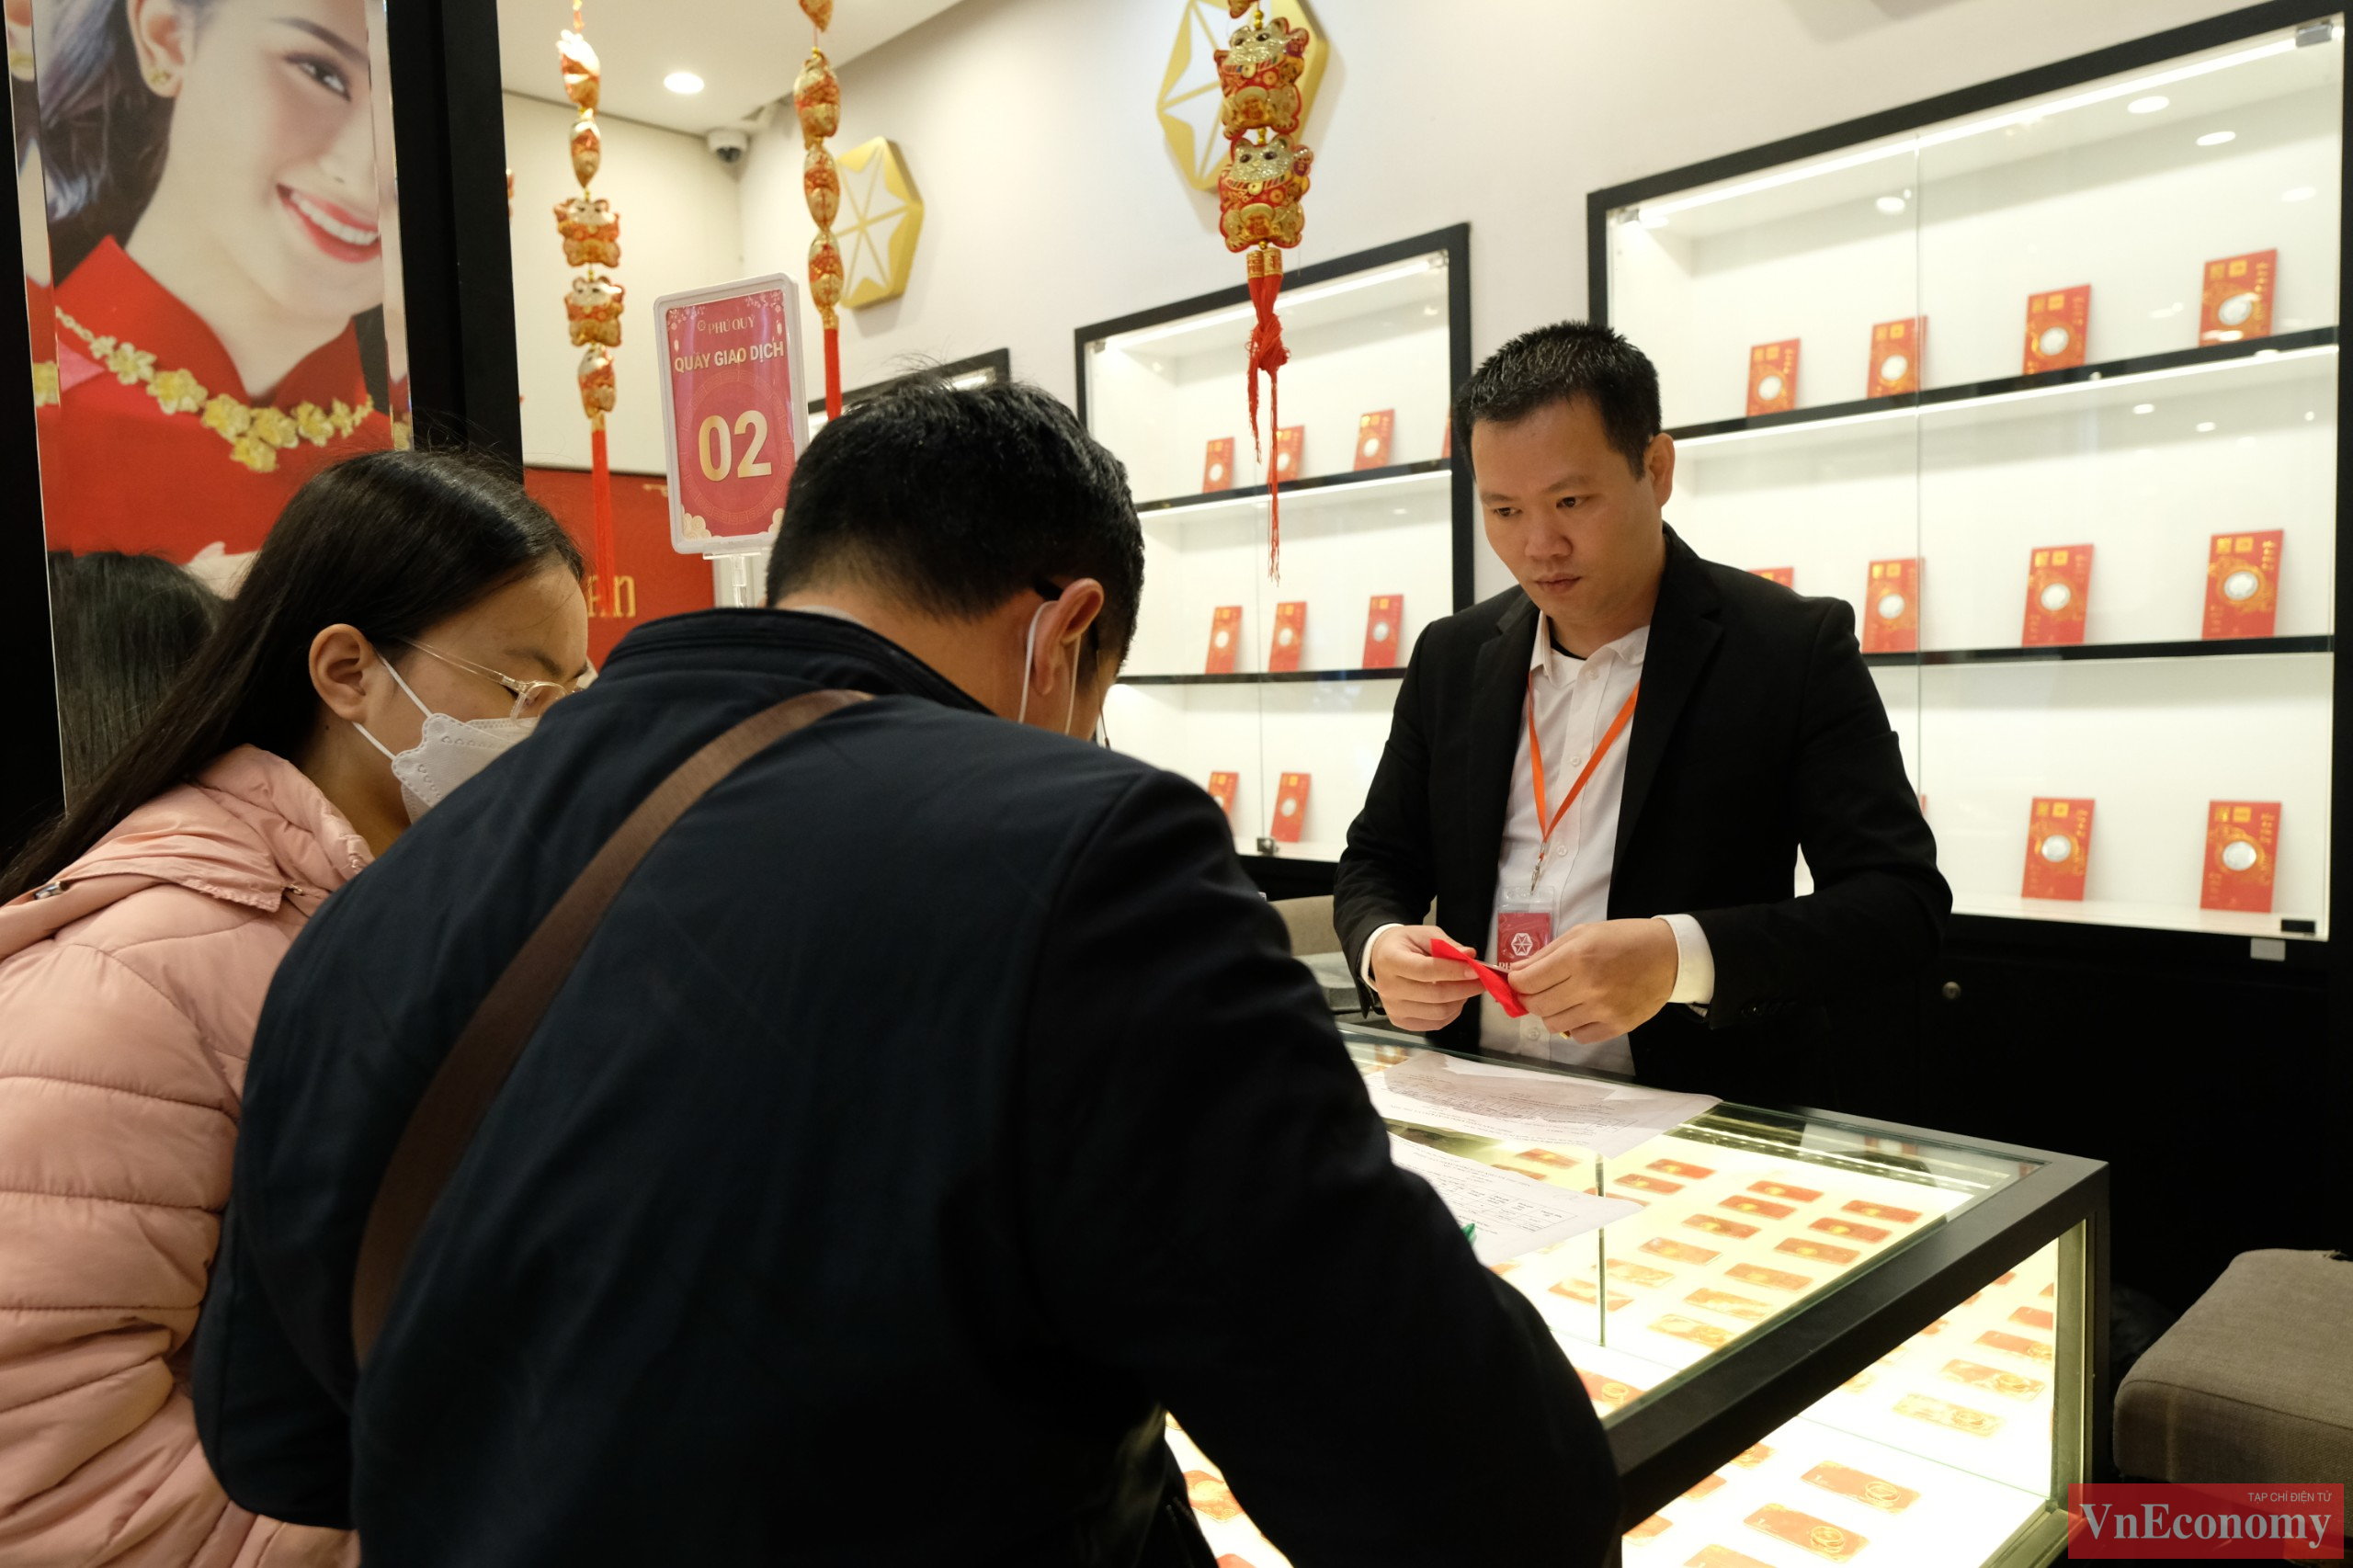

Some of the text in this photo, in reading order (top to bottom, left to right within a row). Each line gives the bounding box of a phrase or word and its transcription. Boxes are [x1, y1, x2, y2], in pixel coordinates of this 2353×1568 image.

[708, 318, 732, 335] PHÚ
[714, 347, 747, 367] GIAO
[749, 341, 785, 363] DỊCH
[699, 410, 772, 482] 02
